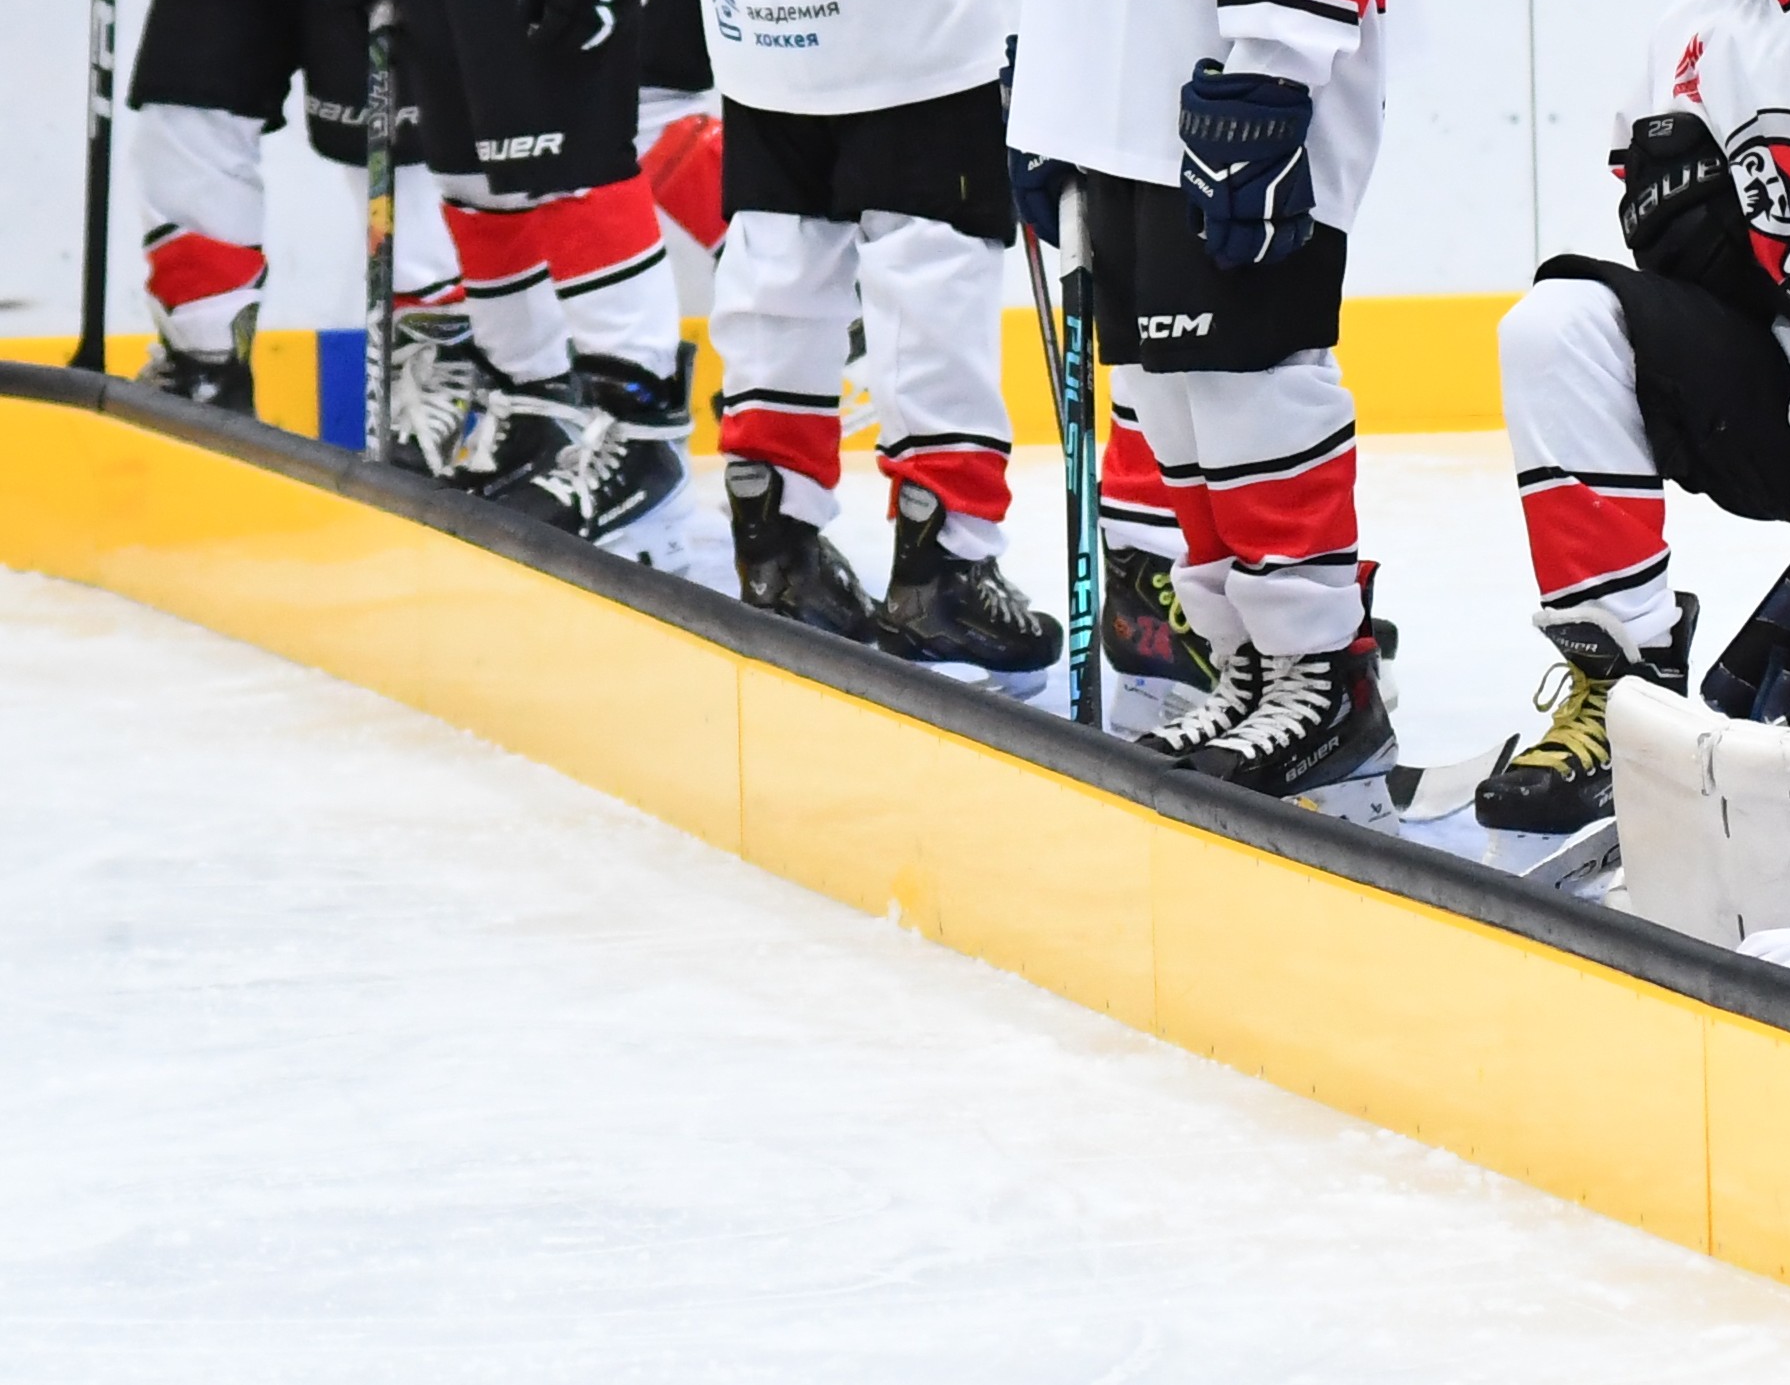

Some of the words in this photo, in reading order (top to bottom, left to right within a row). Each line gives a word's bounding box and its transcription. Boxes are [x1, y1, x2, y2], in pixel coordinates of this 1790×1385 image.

[746, 1, 840, 24] академия
[754, 32, 820, 48] хоккея
[304, 94, 419, 126] BAUR
[475, 132, 565, 162] AUER
[1183, 169, 1214, 198] ALPHA
[1622, 157, 1721, 235] BAUE
[1137, 312, 1214, 339] CCM
[1064, 315, 1083, 495] PULSE
[1555, 636, 1598, 653] AUER
[1285, 736, 1340, 783] BAUER
